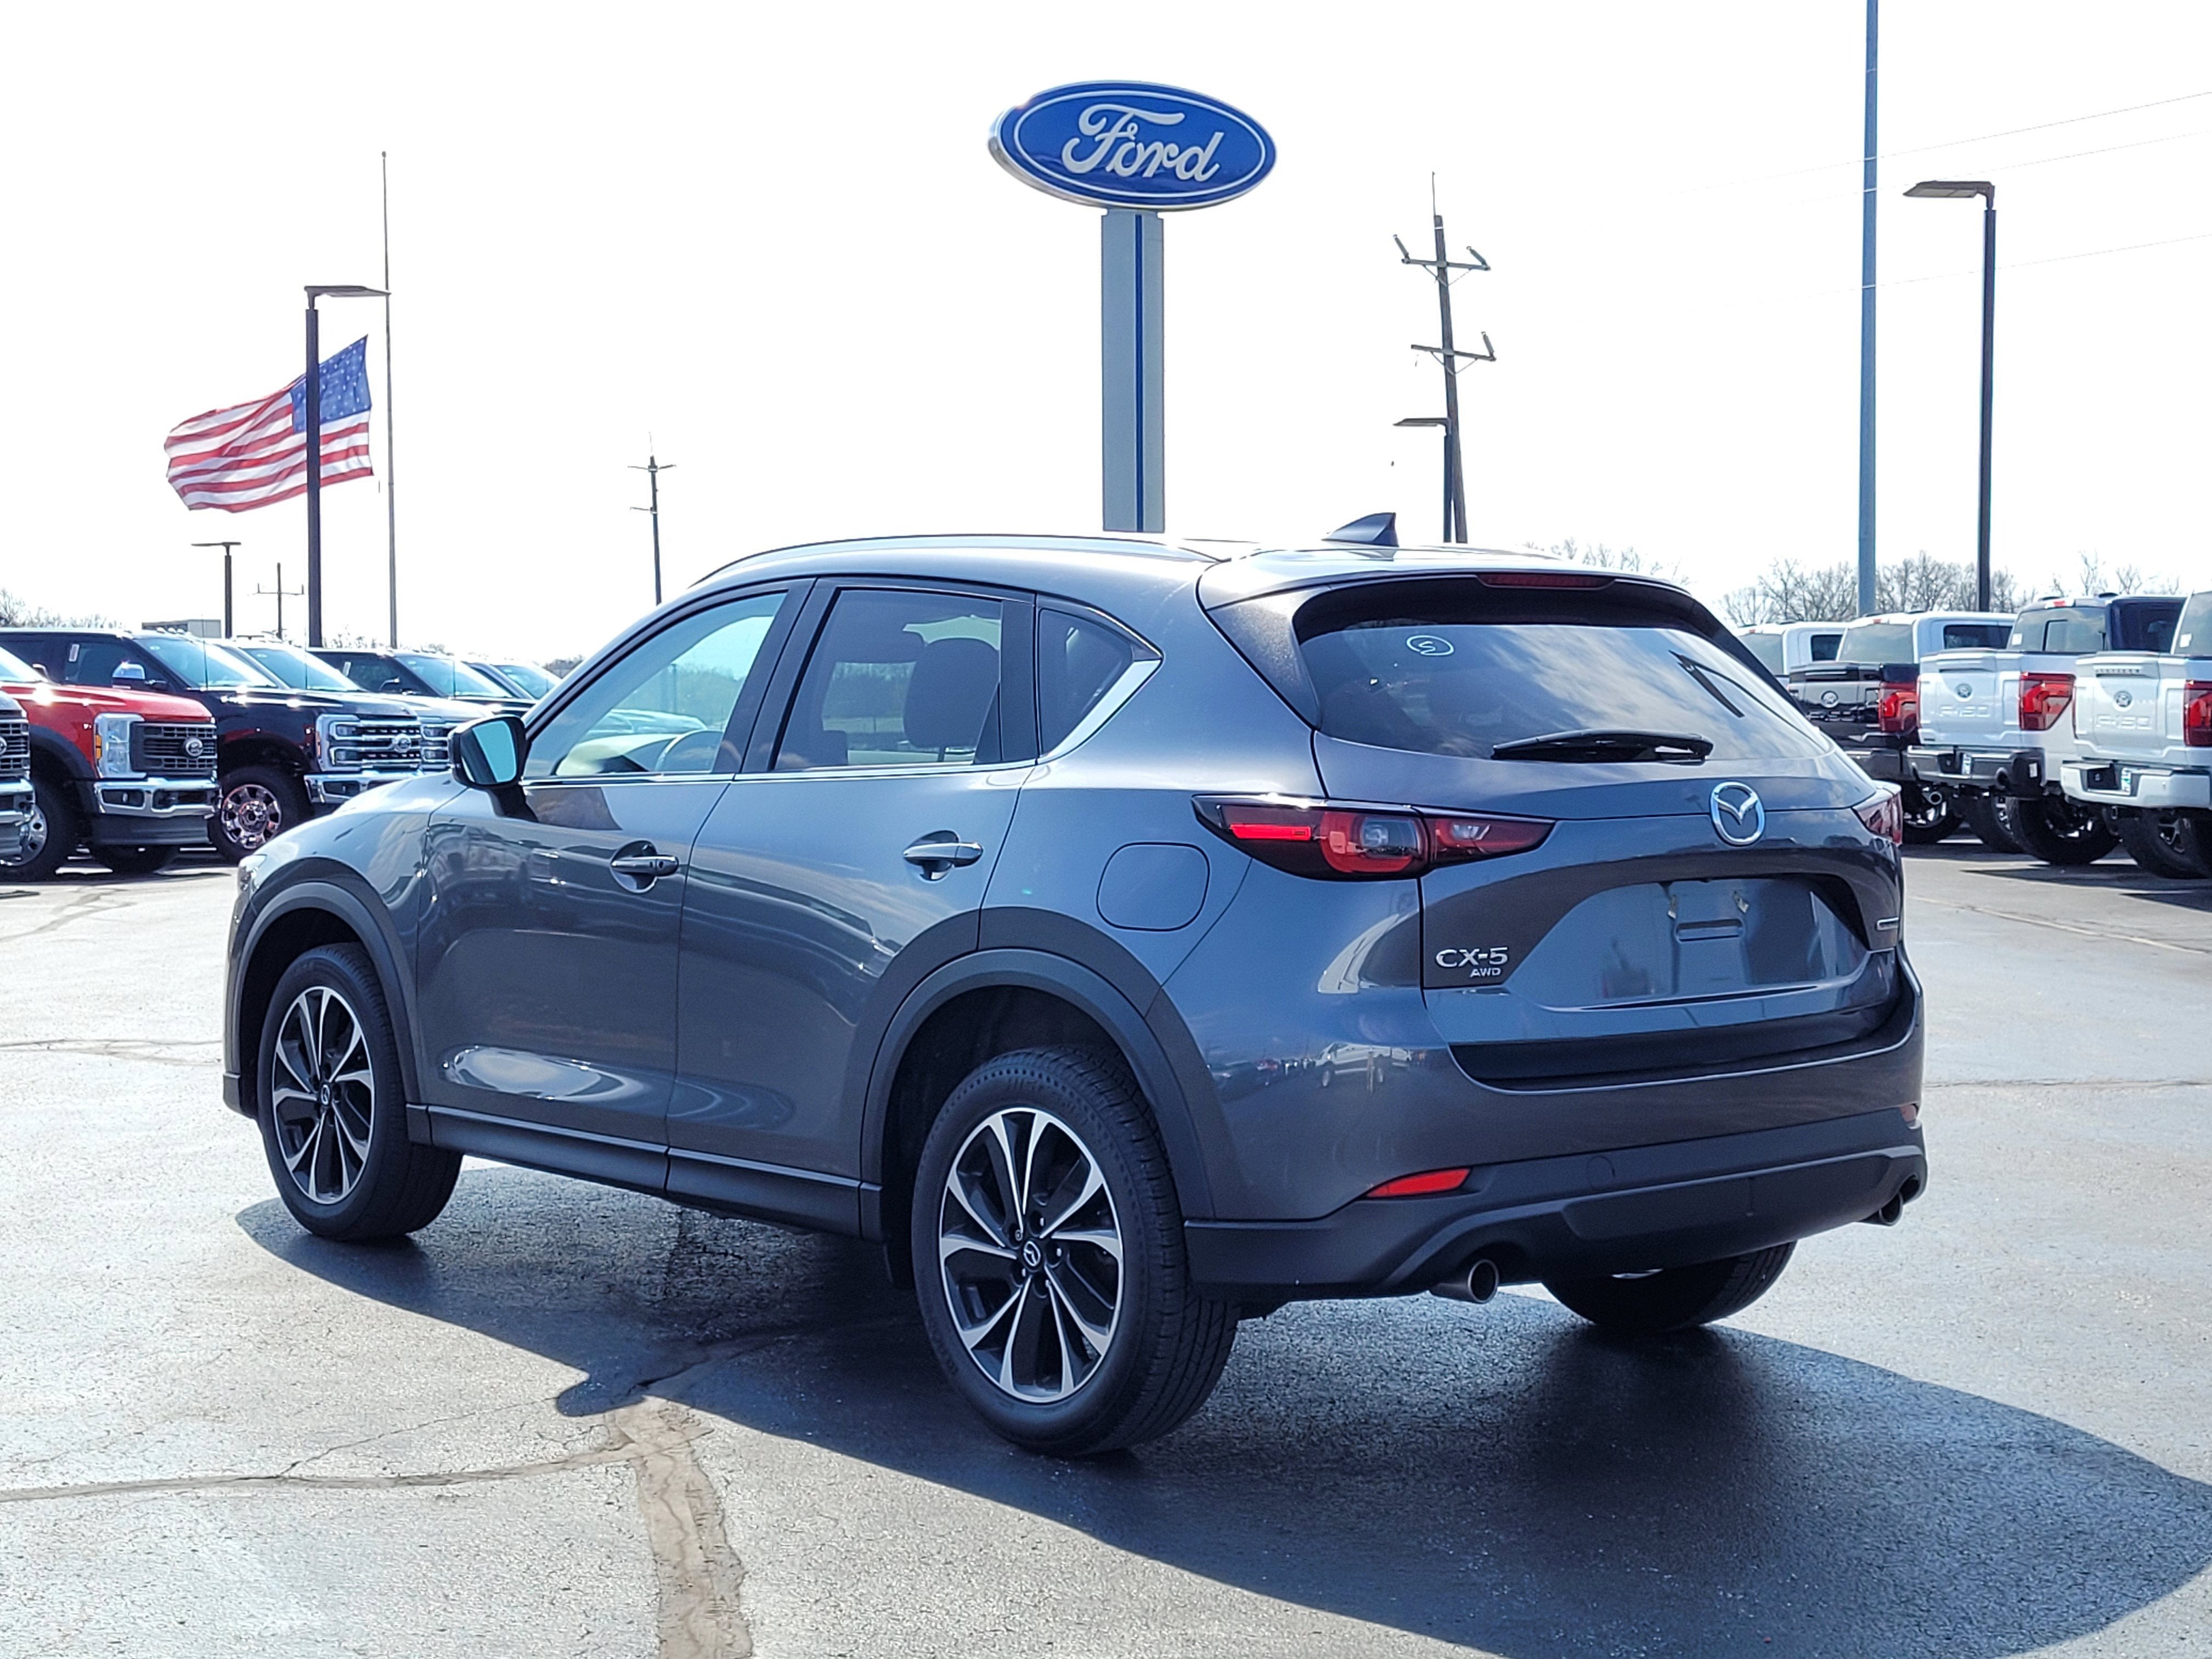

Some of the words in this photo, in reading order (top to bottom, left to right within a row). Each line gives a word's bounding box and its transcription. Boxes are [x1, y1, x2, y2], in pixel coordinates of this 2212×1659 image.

[1062, 103, 1224, 182] Ford
[1436, 947, 1508, 967] CX-5
[1469, 967, 1502, 978] AWD
